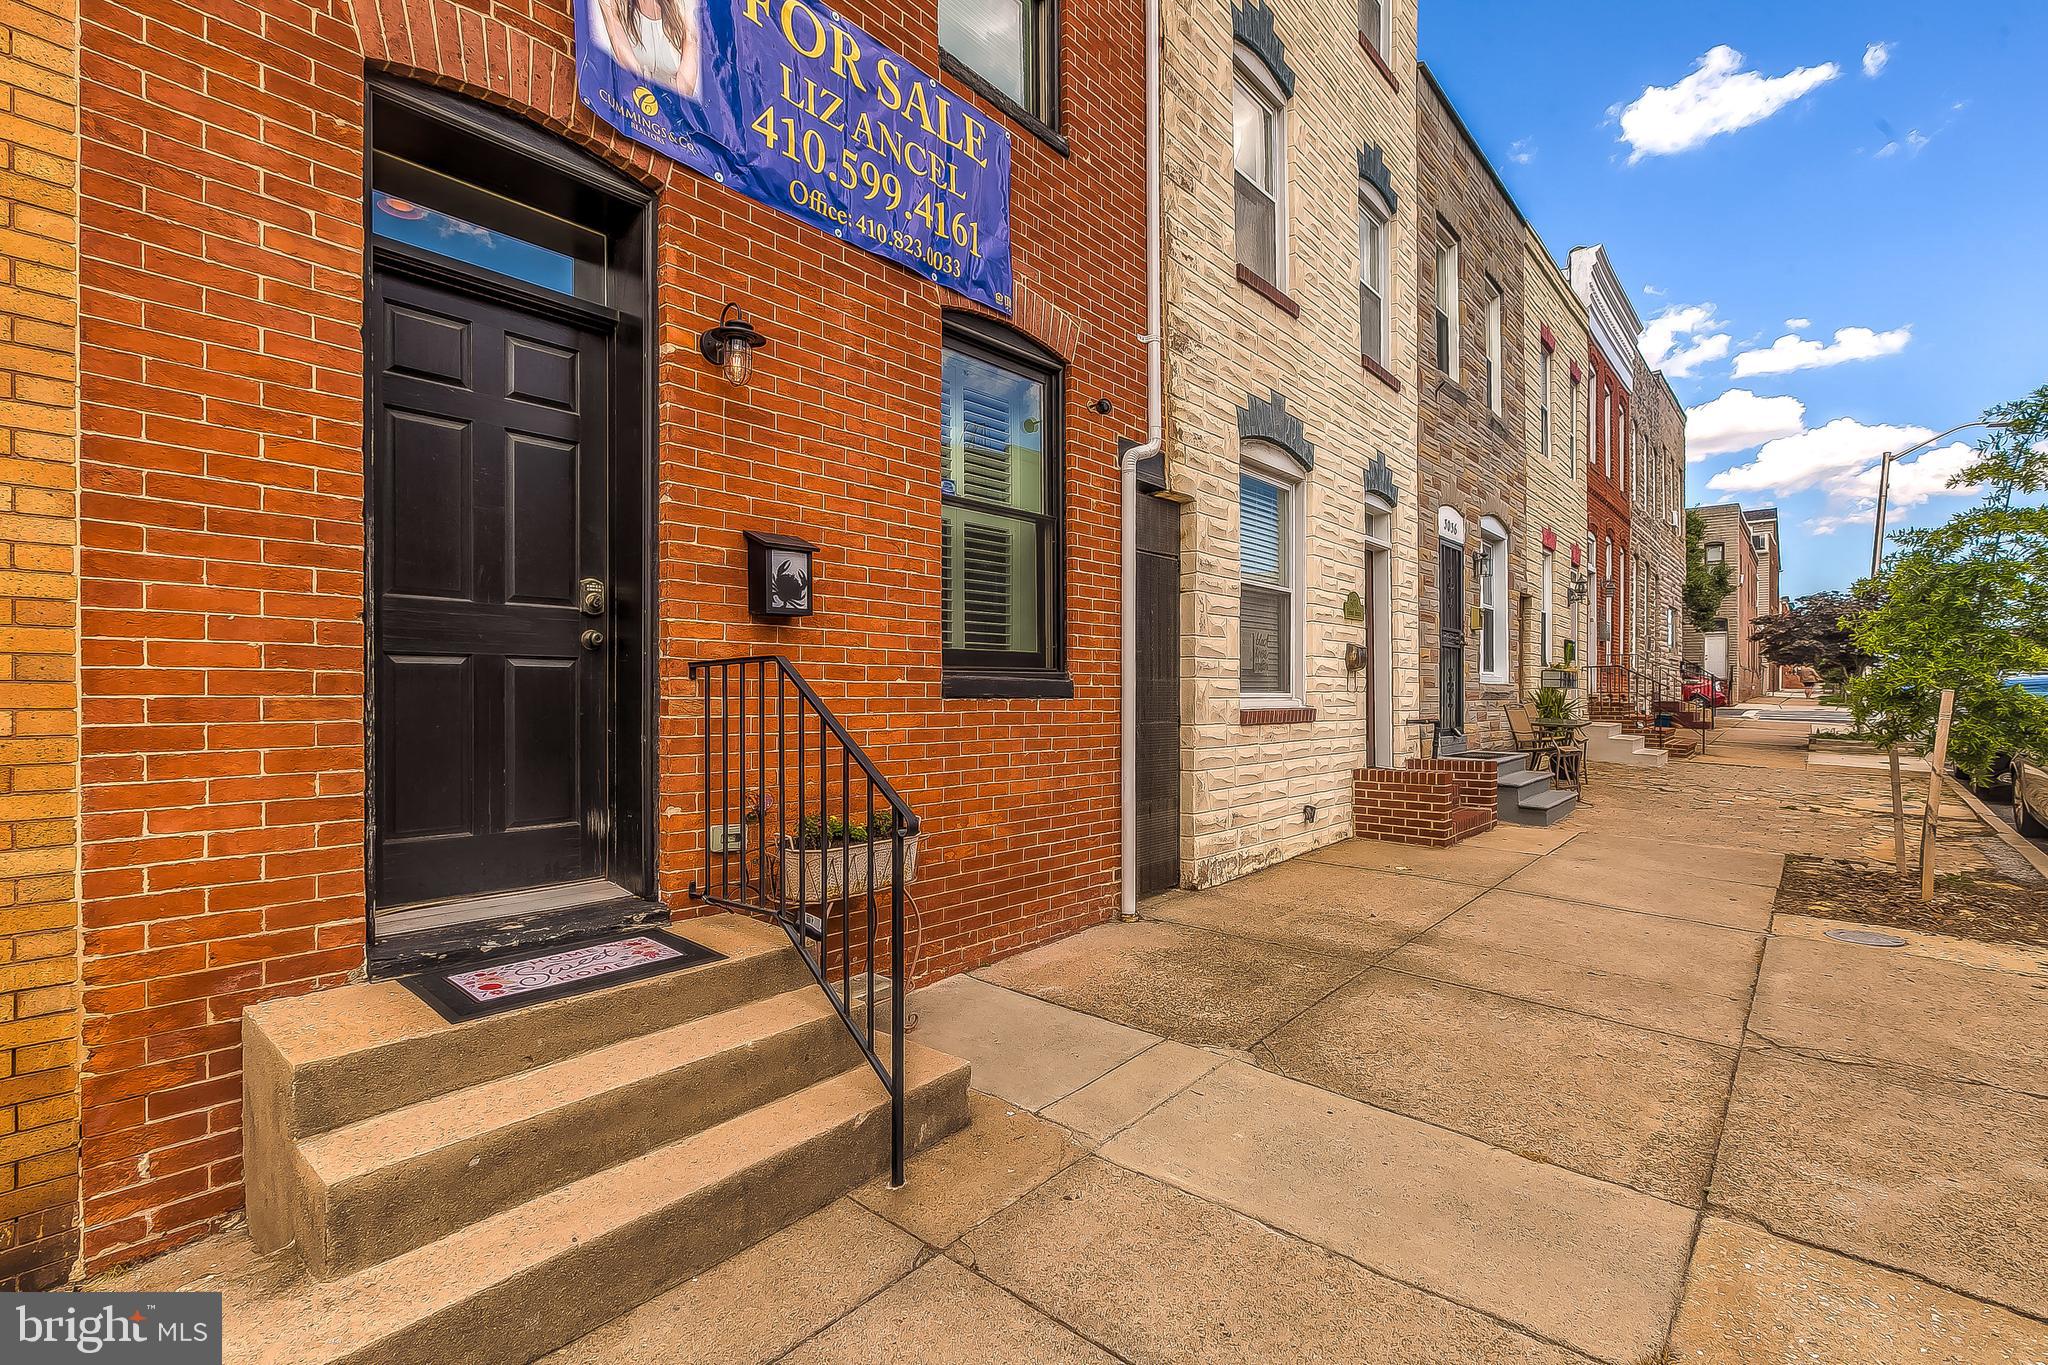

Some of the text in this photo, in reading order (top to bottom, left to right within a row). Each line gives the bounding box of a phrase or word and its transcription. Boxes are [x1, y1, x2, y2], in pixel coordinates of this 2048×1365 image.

[743, 0, 988, 169] FOR SALE
[599, 88, 668, 139] CUMMINGS
[668, 131, 681, 145] &
[630, 120, 666, 145] REALTORS
[780, 62, 967, 200] LIZ ANCEL
[751, 105, 983, 259] 410.599.4161
[789, 180, 962, 278] Office: 410.823.0033
[514, 948, 618, 987] Sweet
[529, 947, 597, 965] HOME
[557, 961, 628, 981] HOME
